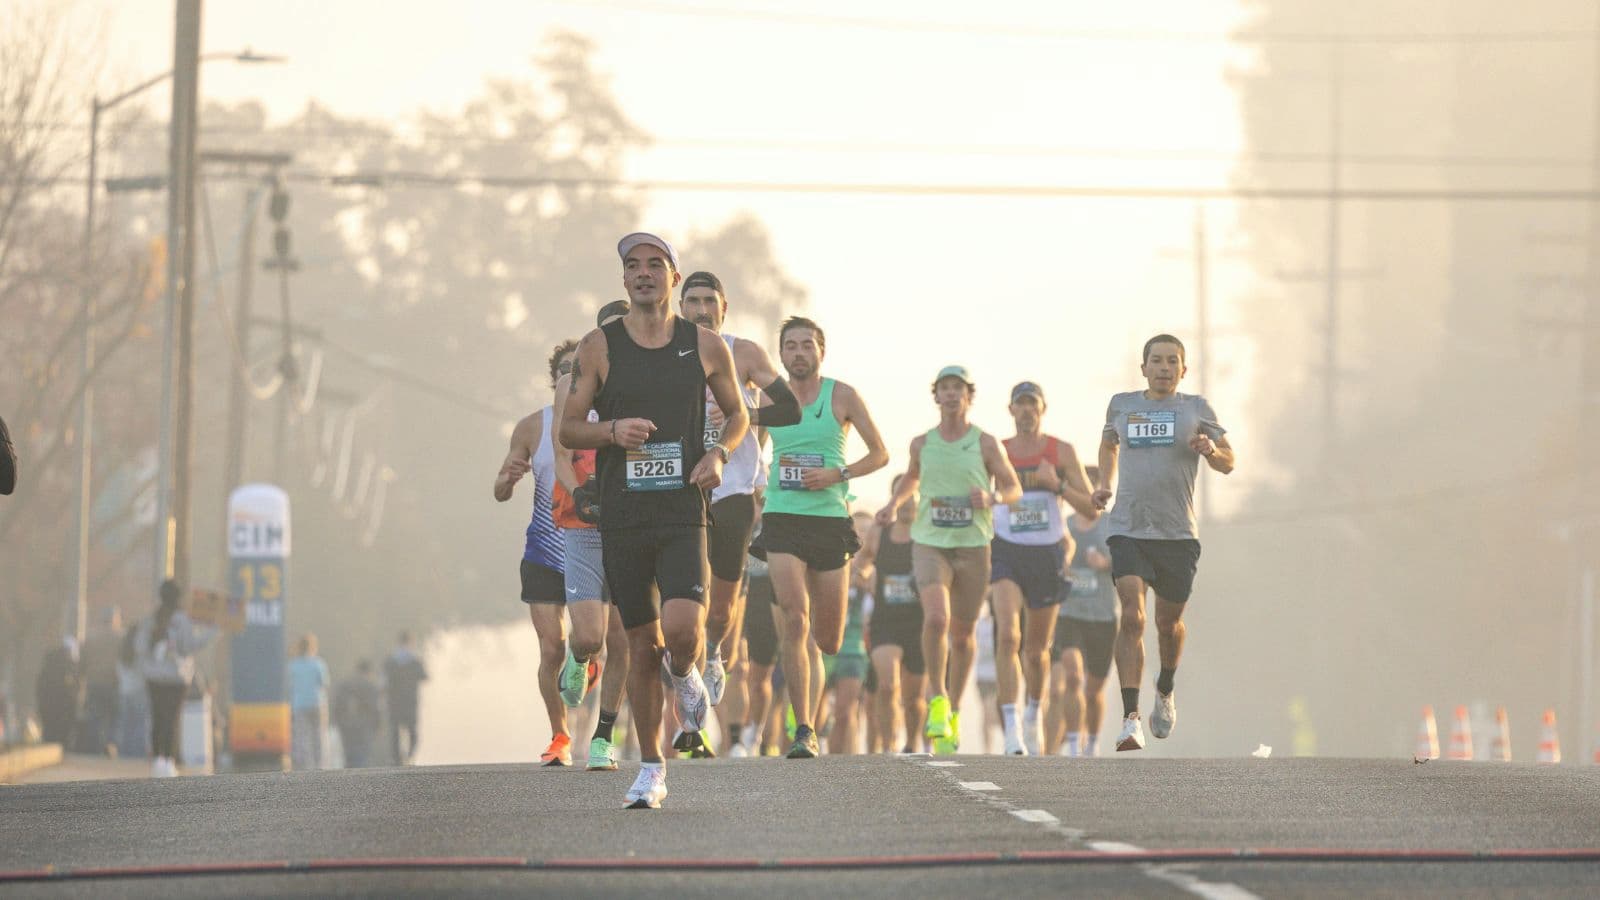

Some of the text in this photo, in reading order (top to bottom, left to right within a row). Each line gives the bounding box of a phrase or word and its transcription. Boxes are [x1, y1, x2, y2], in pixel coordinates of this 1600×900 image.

[1135, 423, 1167, 436] 1169
[634, 460, 675, 477] 5226
[239, 564, 281, 600] 13
